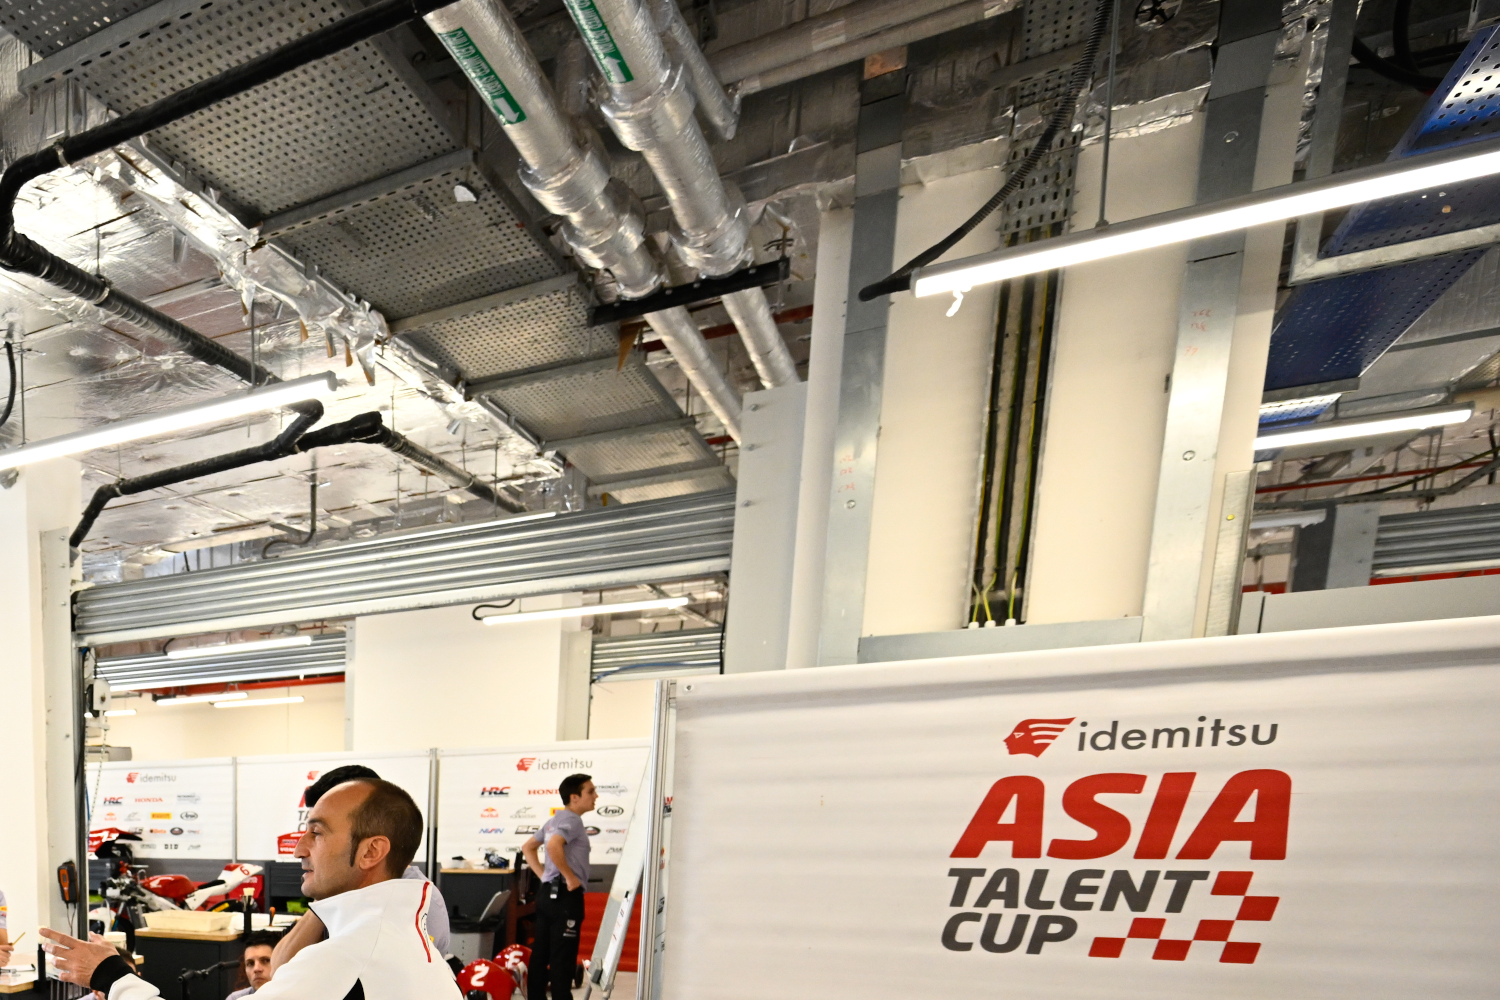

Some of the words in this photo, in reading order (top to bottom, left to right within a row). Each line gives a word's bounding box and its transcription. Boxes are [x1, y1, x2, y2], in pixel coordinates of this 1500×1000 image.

[1077, 716, 1279, 751] idemitsu
[538, 757, 593, 770] idemitsu
[140, 773, 176, 782] idemitsu
[481, 786, 511, 796] HRC
[601, 806, 620, 816] Arai
[949, 769, 1292, 860] ASIA
[947, 867, 1210, 913] TALENT
[940, 912, 1078, 954] CUP
